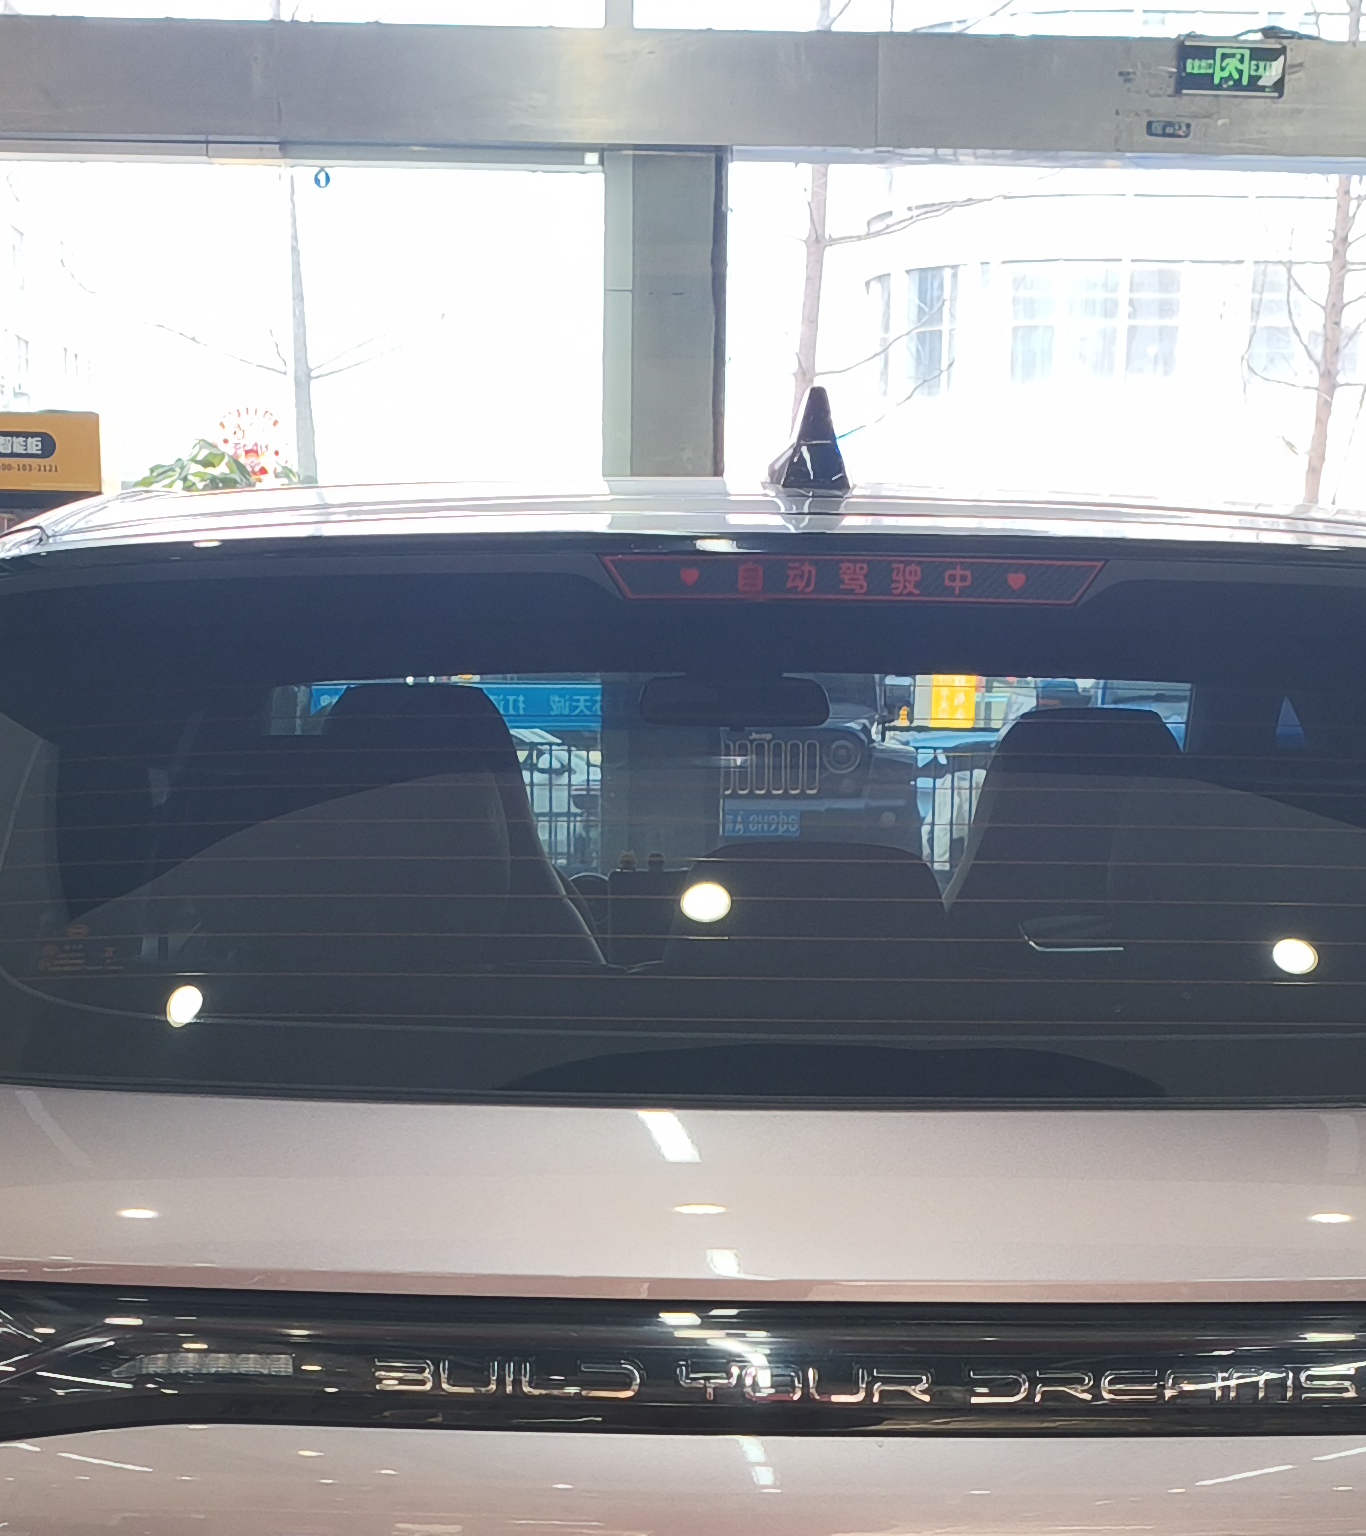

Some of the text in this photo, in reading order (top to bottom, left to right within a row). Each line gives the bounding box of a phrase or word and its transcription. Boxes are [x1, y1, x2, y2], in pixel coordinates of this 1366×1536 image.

[736, 561, 973, 597] 自动驾驶中
[373, 1356, 644, 1400] BUILD
